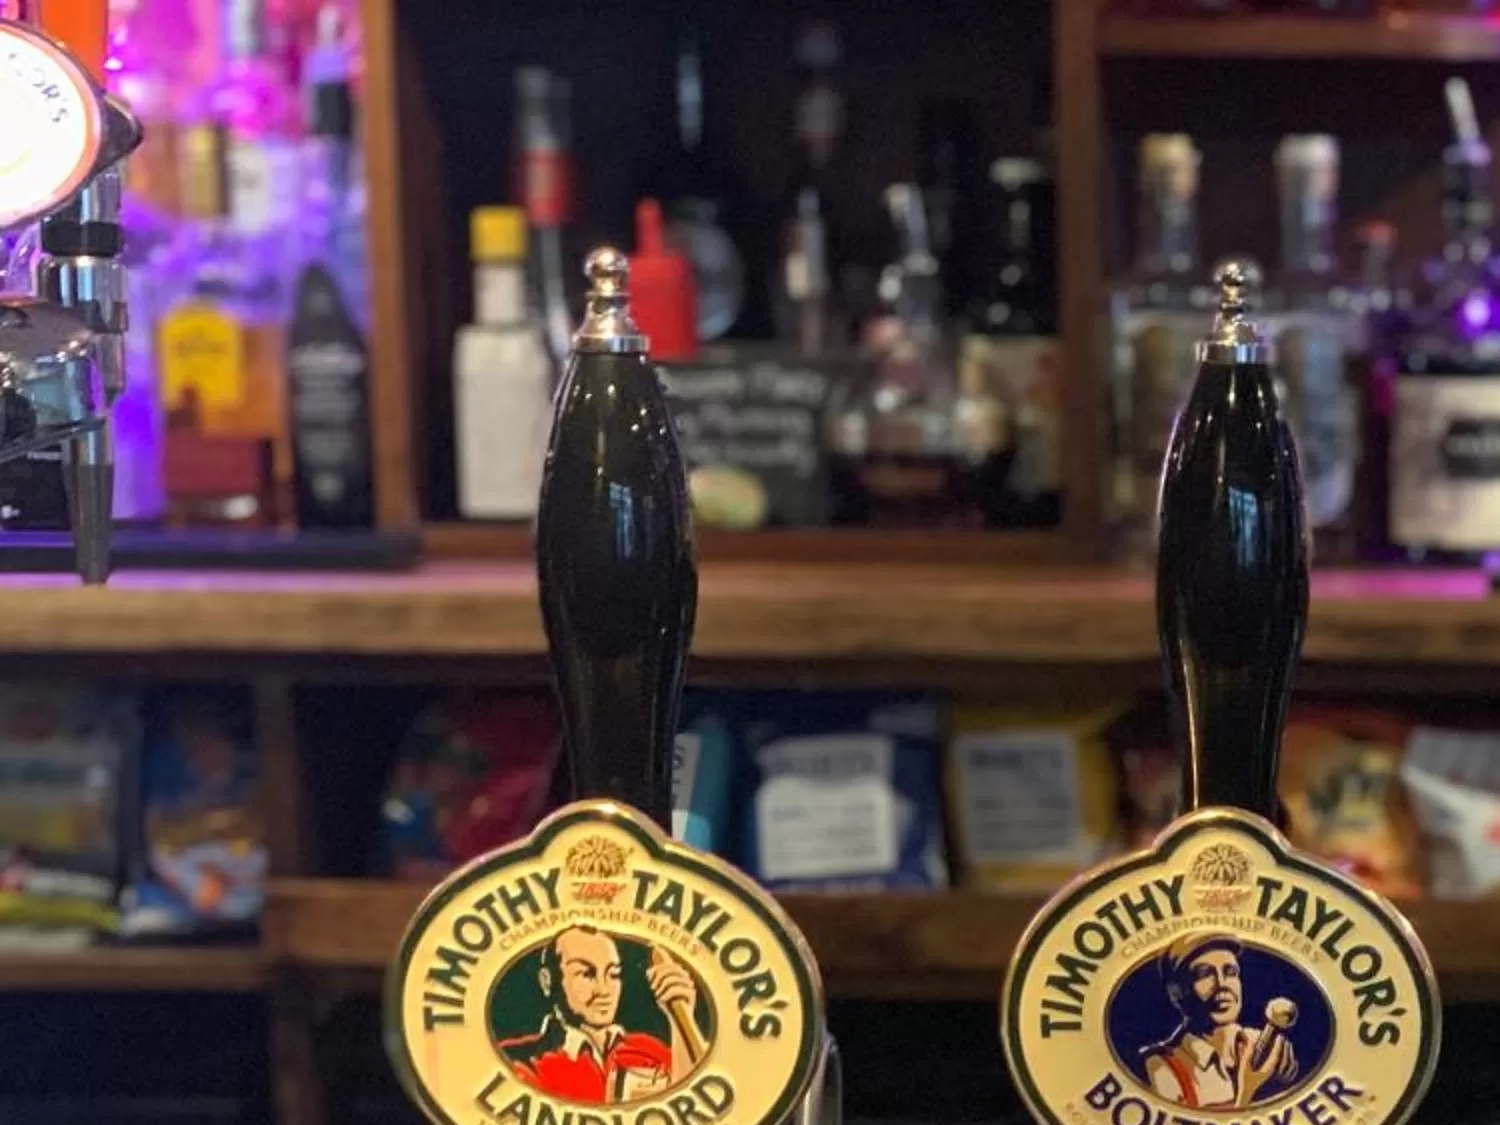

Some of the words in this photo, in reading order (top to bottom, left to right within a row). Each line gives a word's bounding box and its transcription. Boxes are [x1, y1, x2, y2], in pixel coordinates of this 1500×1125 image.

[423, 867, 561, 1031] TIMOTHY
[631, 870, 790, 1040] TAYLOR'S
[500, 907, 641, 952] CHAMPIONSHIP
[647, 916, 699, 957] BEERS
[1040, 874, 1184, 1039] TIMOTHY
[1256, 877, 1407, 1047] TAYLOR'S
[1121, 914, 1266, 958] CHAMPIONSHIP
